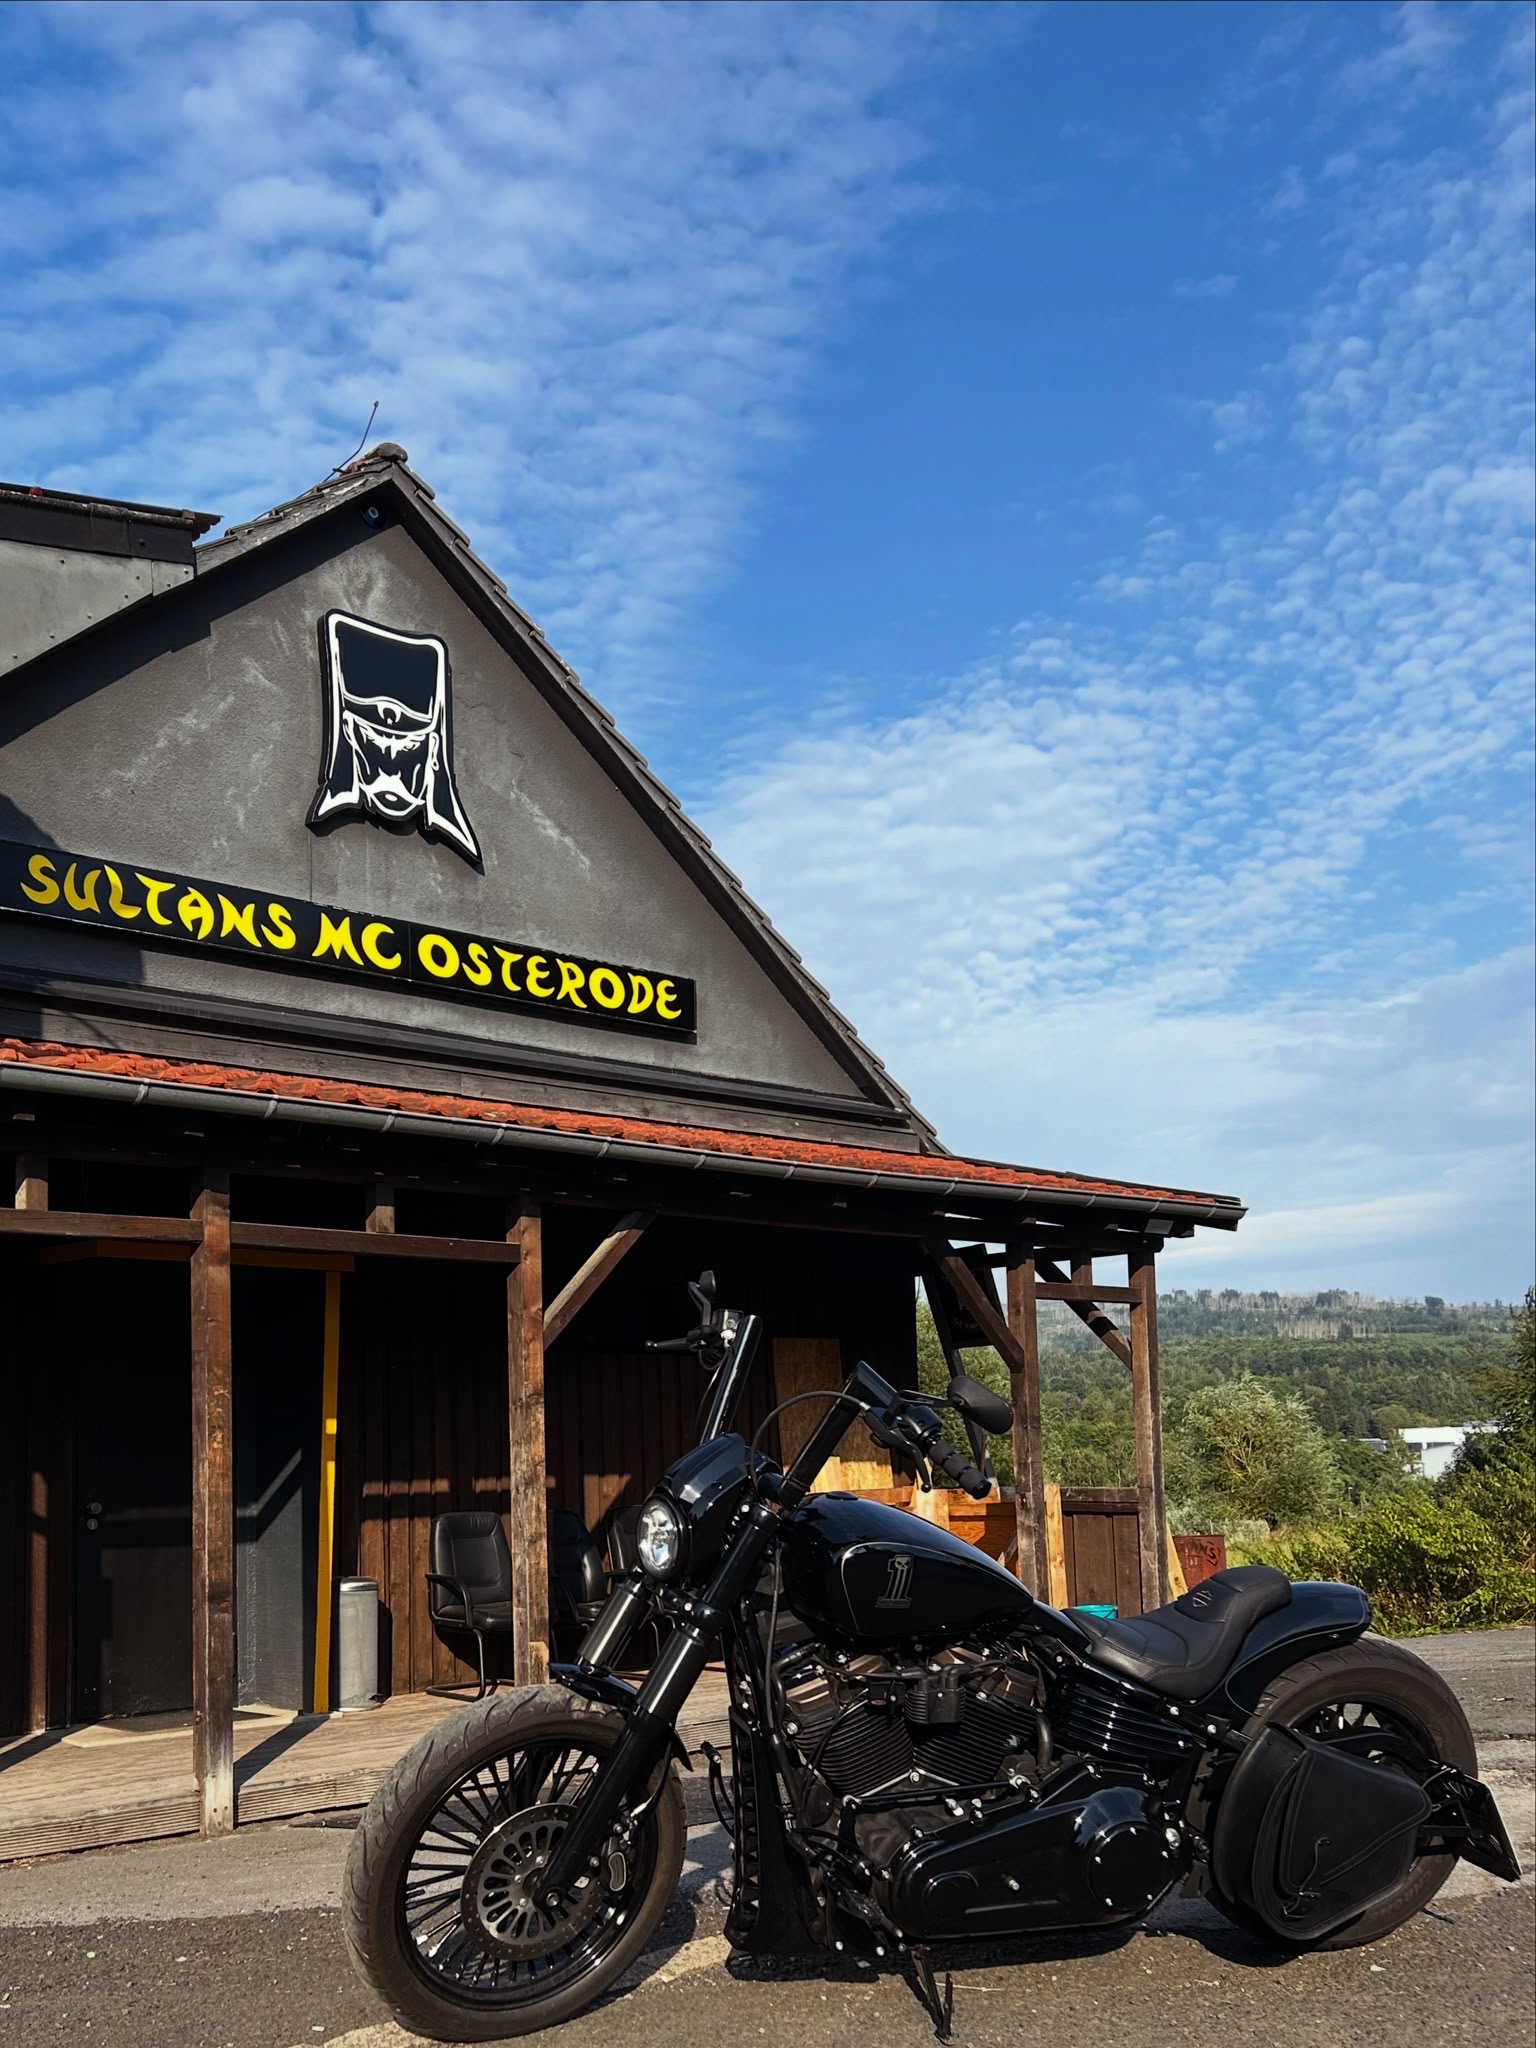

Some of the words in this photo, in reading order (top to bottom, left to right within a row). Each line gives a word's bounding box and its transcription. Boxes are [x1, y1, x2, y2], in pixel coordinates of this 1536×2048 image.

[20, 854, 297, 951] SULTANS
[311, 912, 402, 970] MC
[417, 933, 682, 1020] OSTERODE
